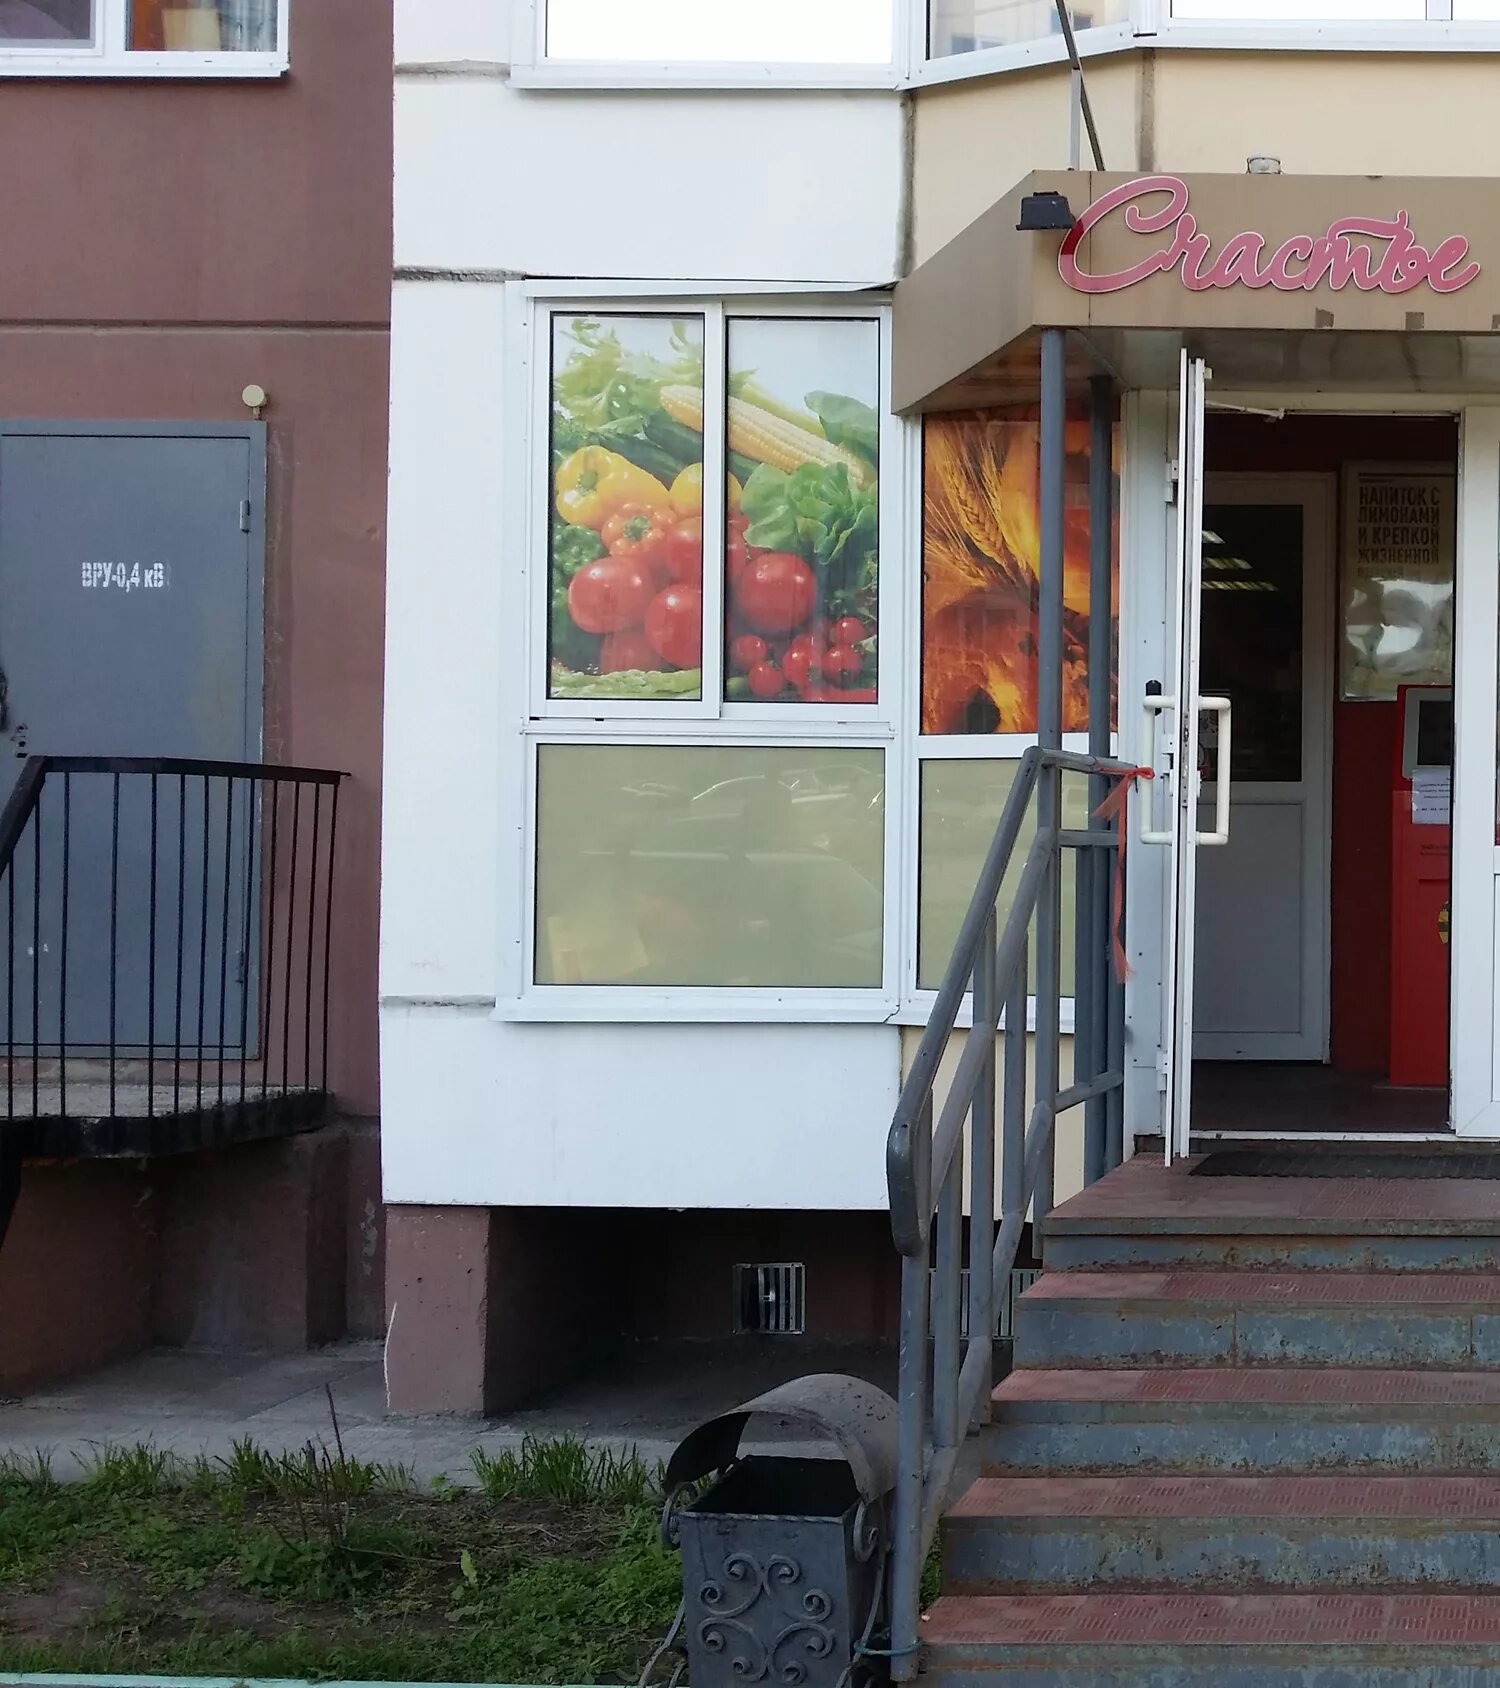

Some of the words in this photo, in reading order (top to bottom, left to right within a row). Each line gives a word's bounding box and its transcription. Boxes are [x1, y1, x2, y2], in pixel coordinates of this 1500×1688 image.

[1058, 175, 1481, 294] Счастье
[1358, 486, 1427, 505] НАПИТОК
[1358, 506, 1440, 524] ЛИМОНАМИ
[1358, 527, 1367, 545] И
[1372, 524, 1439, 545] КРЕПКОЙ
[1358, 547, 1439, 564] ЖИЗНЕННОЙ
